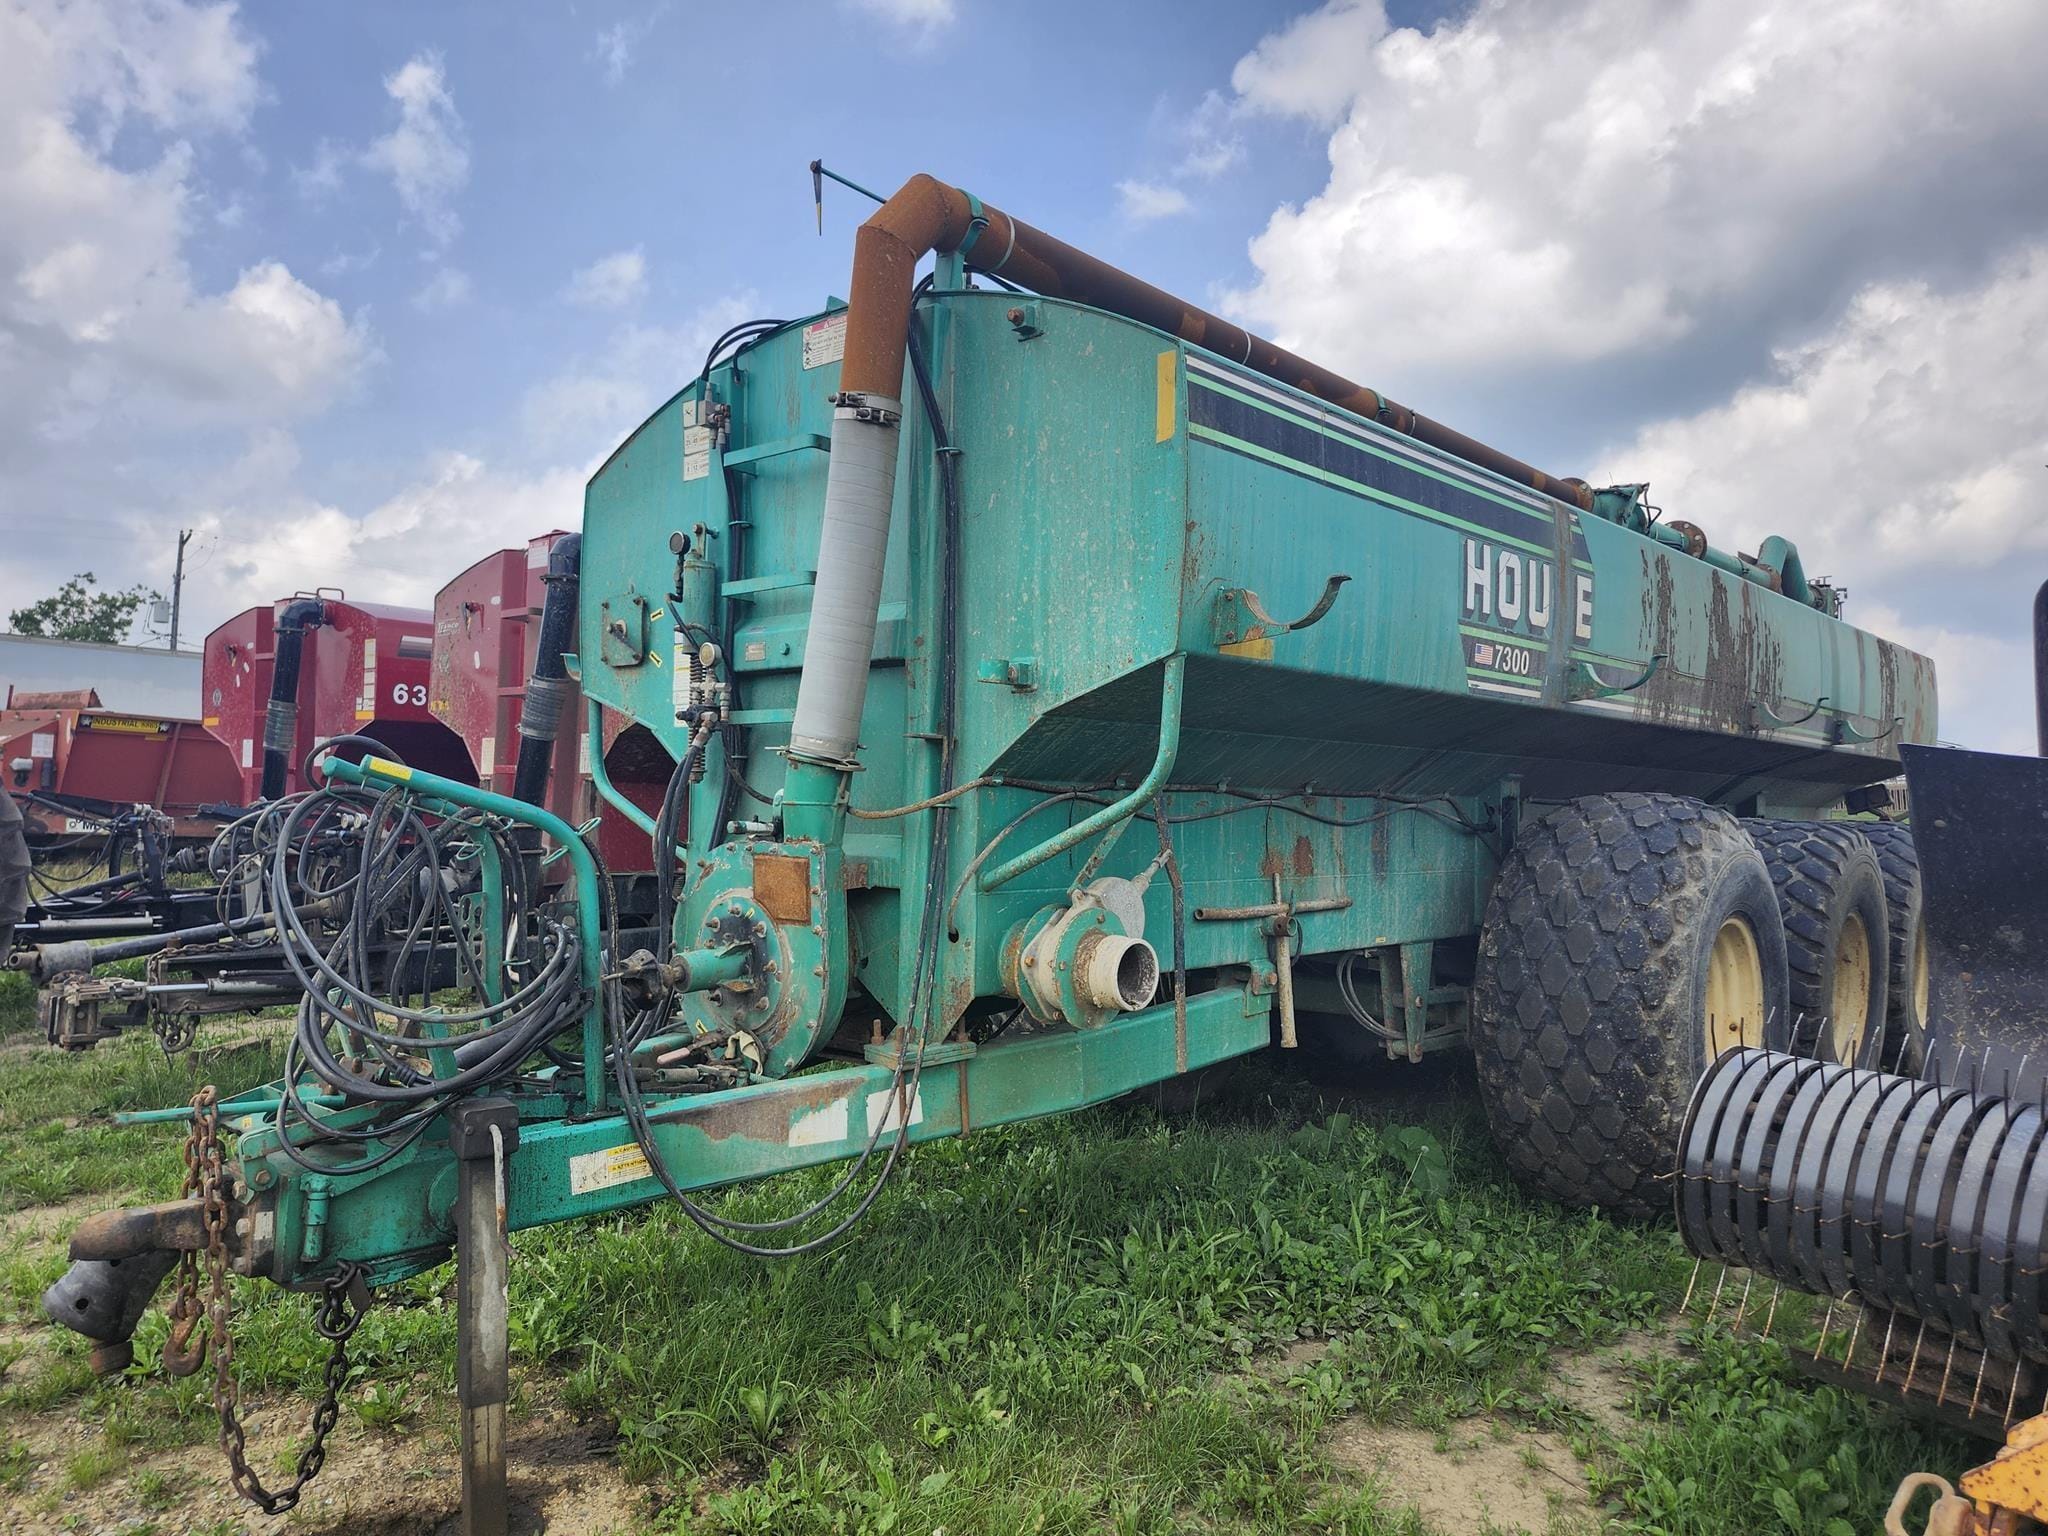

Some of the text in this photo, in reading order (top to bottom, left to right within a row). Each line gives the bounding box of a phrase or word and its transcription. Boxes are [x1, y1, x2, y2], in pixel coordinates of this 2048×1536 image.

[1465, 538, 1593, 644] HOUE
[1494, 645, 1530, 675] 7300
[393, 683, 427, 706] 63
[93, 716, 138, 729] INDUSTRIAL
